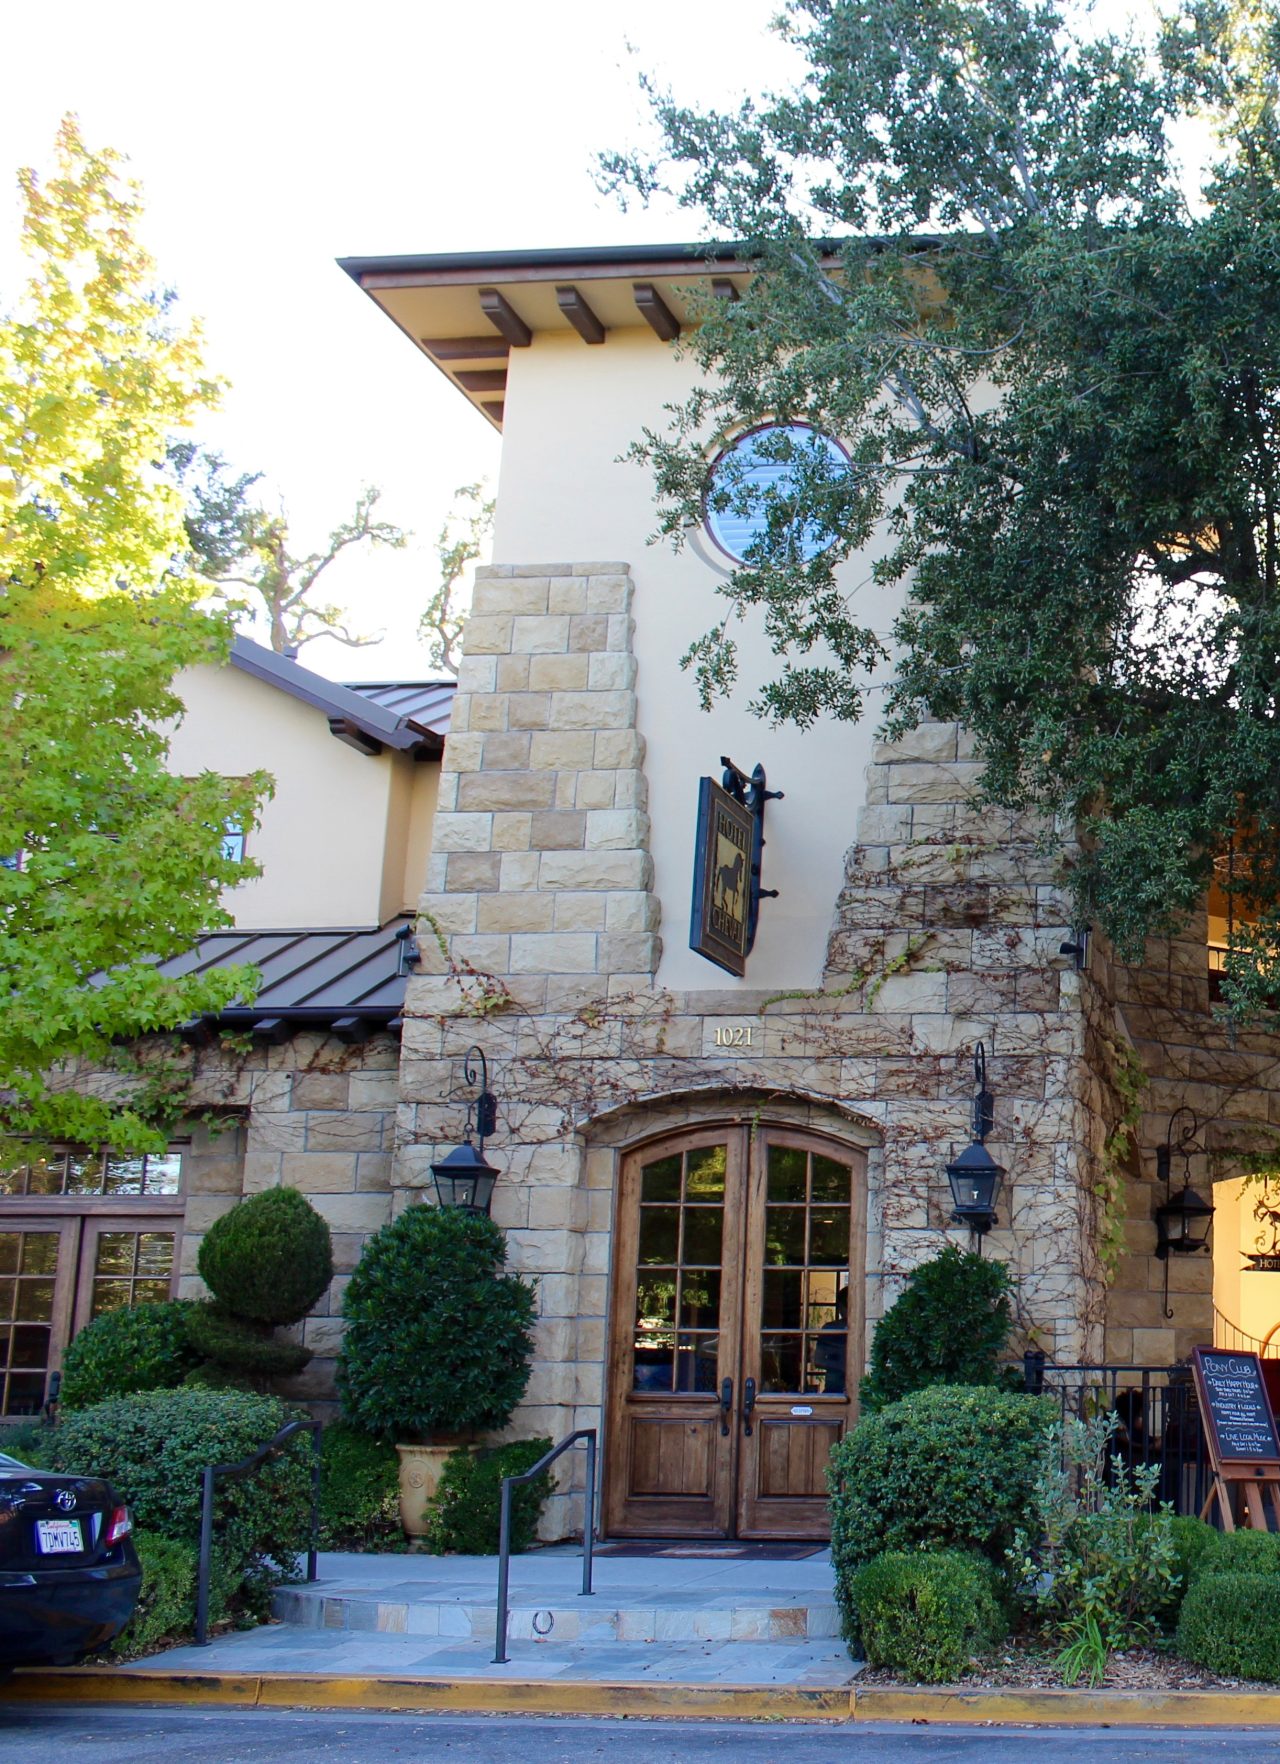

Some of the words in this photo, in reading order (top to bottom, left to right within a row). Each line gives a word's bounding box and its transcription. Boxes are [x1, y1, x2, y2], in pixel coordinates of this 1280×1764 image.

[712, 907, 742, 945] CHEVAL
[714, 1026, 753, 1047] 1021
[1204, 1356, 1228, 1372] PONY
[1228, 1359, 1251, 1375] CLUB
[42, 1531, 80, 1548] 7DMV745
